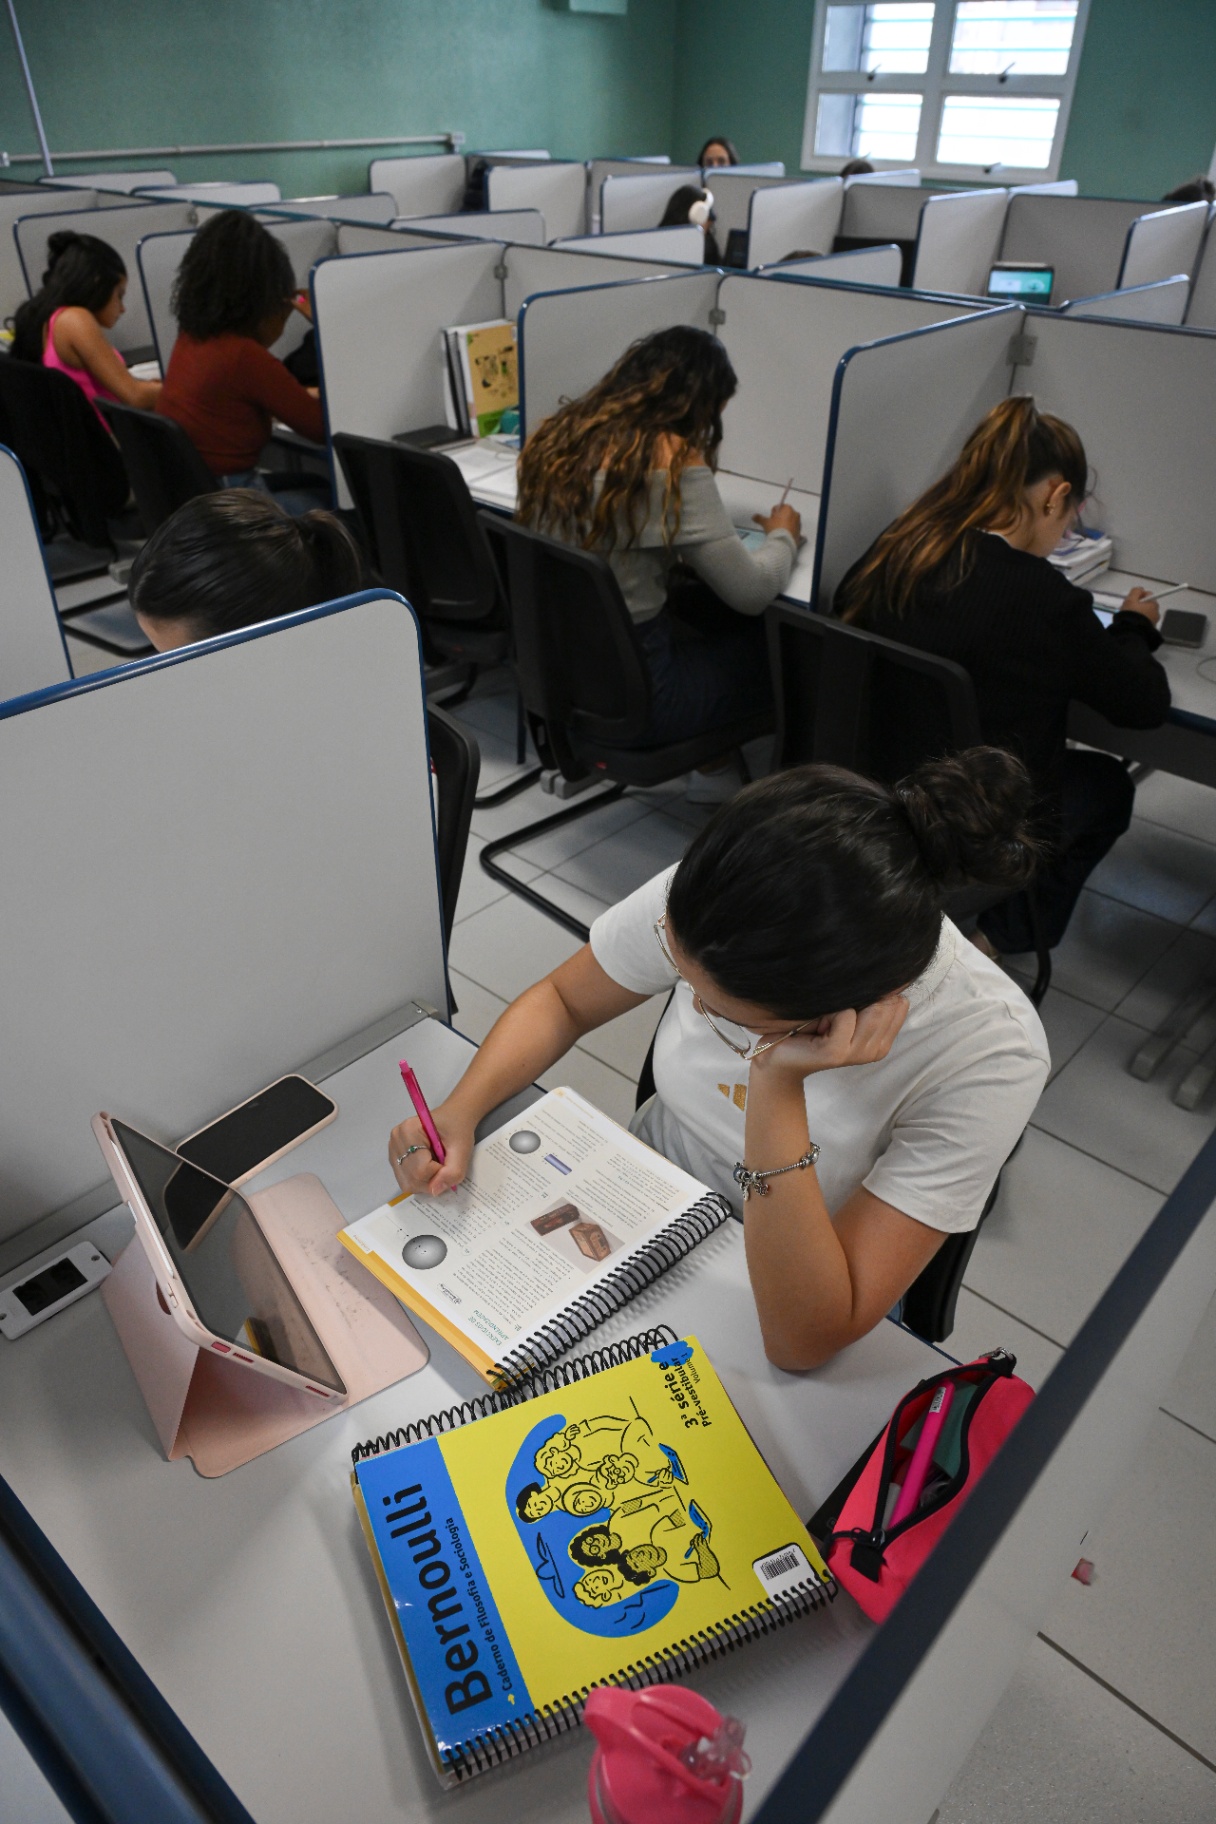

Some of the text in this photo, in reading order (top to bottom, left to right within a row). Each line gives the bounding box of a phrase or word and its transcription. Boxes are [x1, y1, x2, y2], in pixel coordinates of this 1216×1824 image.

[659, 1361, 669, 1370] e
[664, 1373, 689, 1410] série
[671, 1357, 712, 1428] Pré-vestibular
[685, 1358, 700, 1383] Volume
[382, 1483, 493, 1715] Bernoulli
[445, 1517, 513, 1691] Caderno de Filosofia e Sociologia
